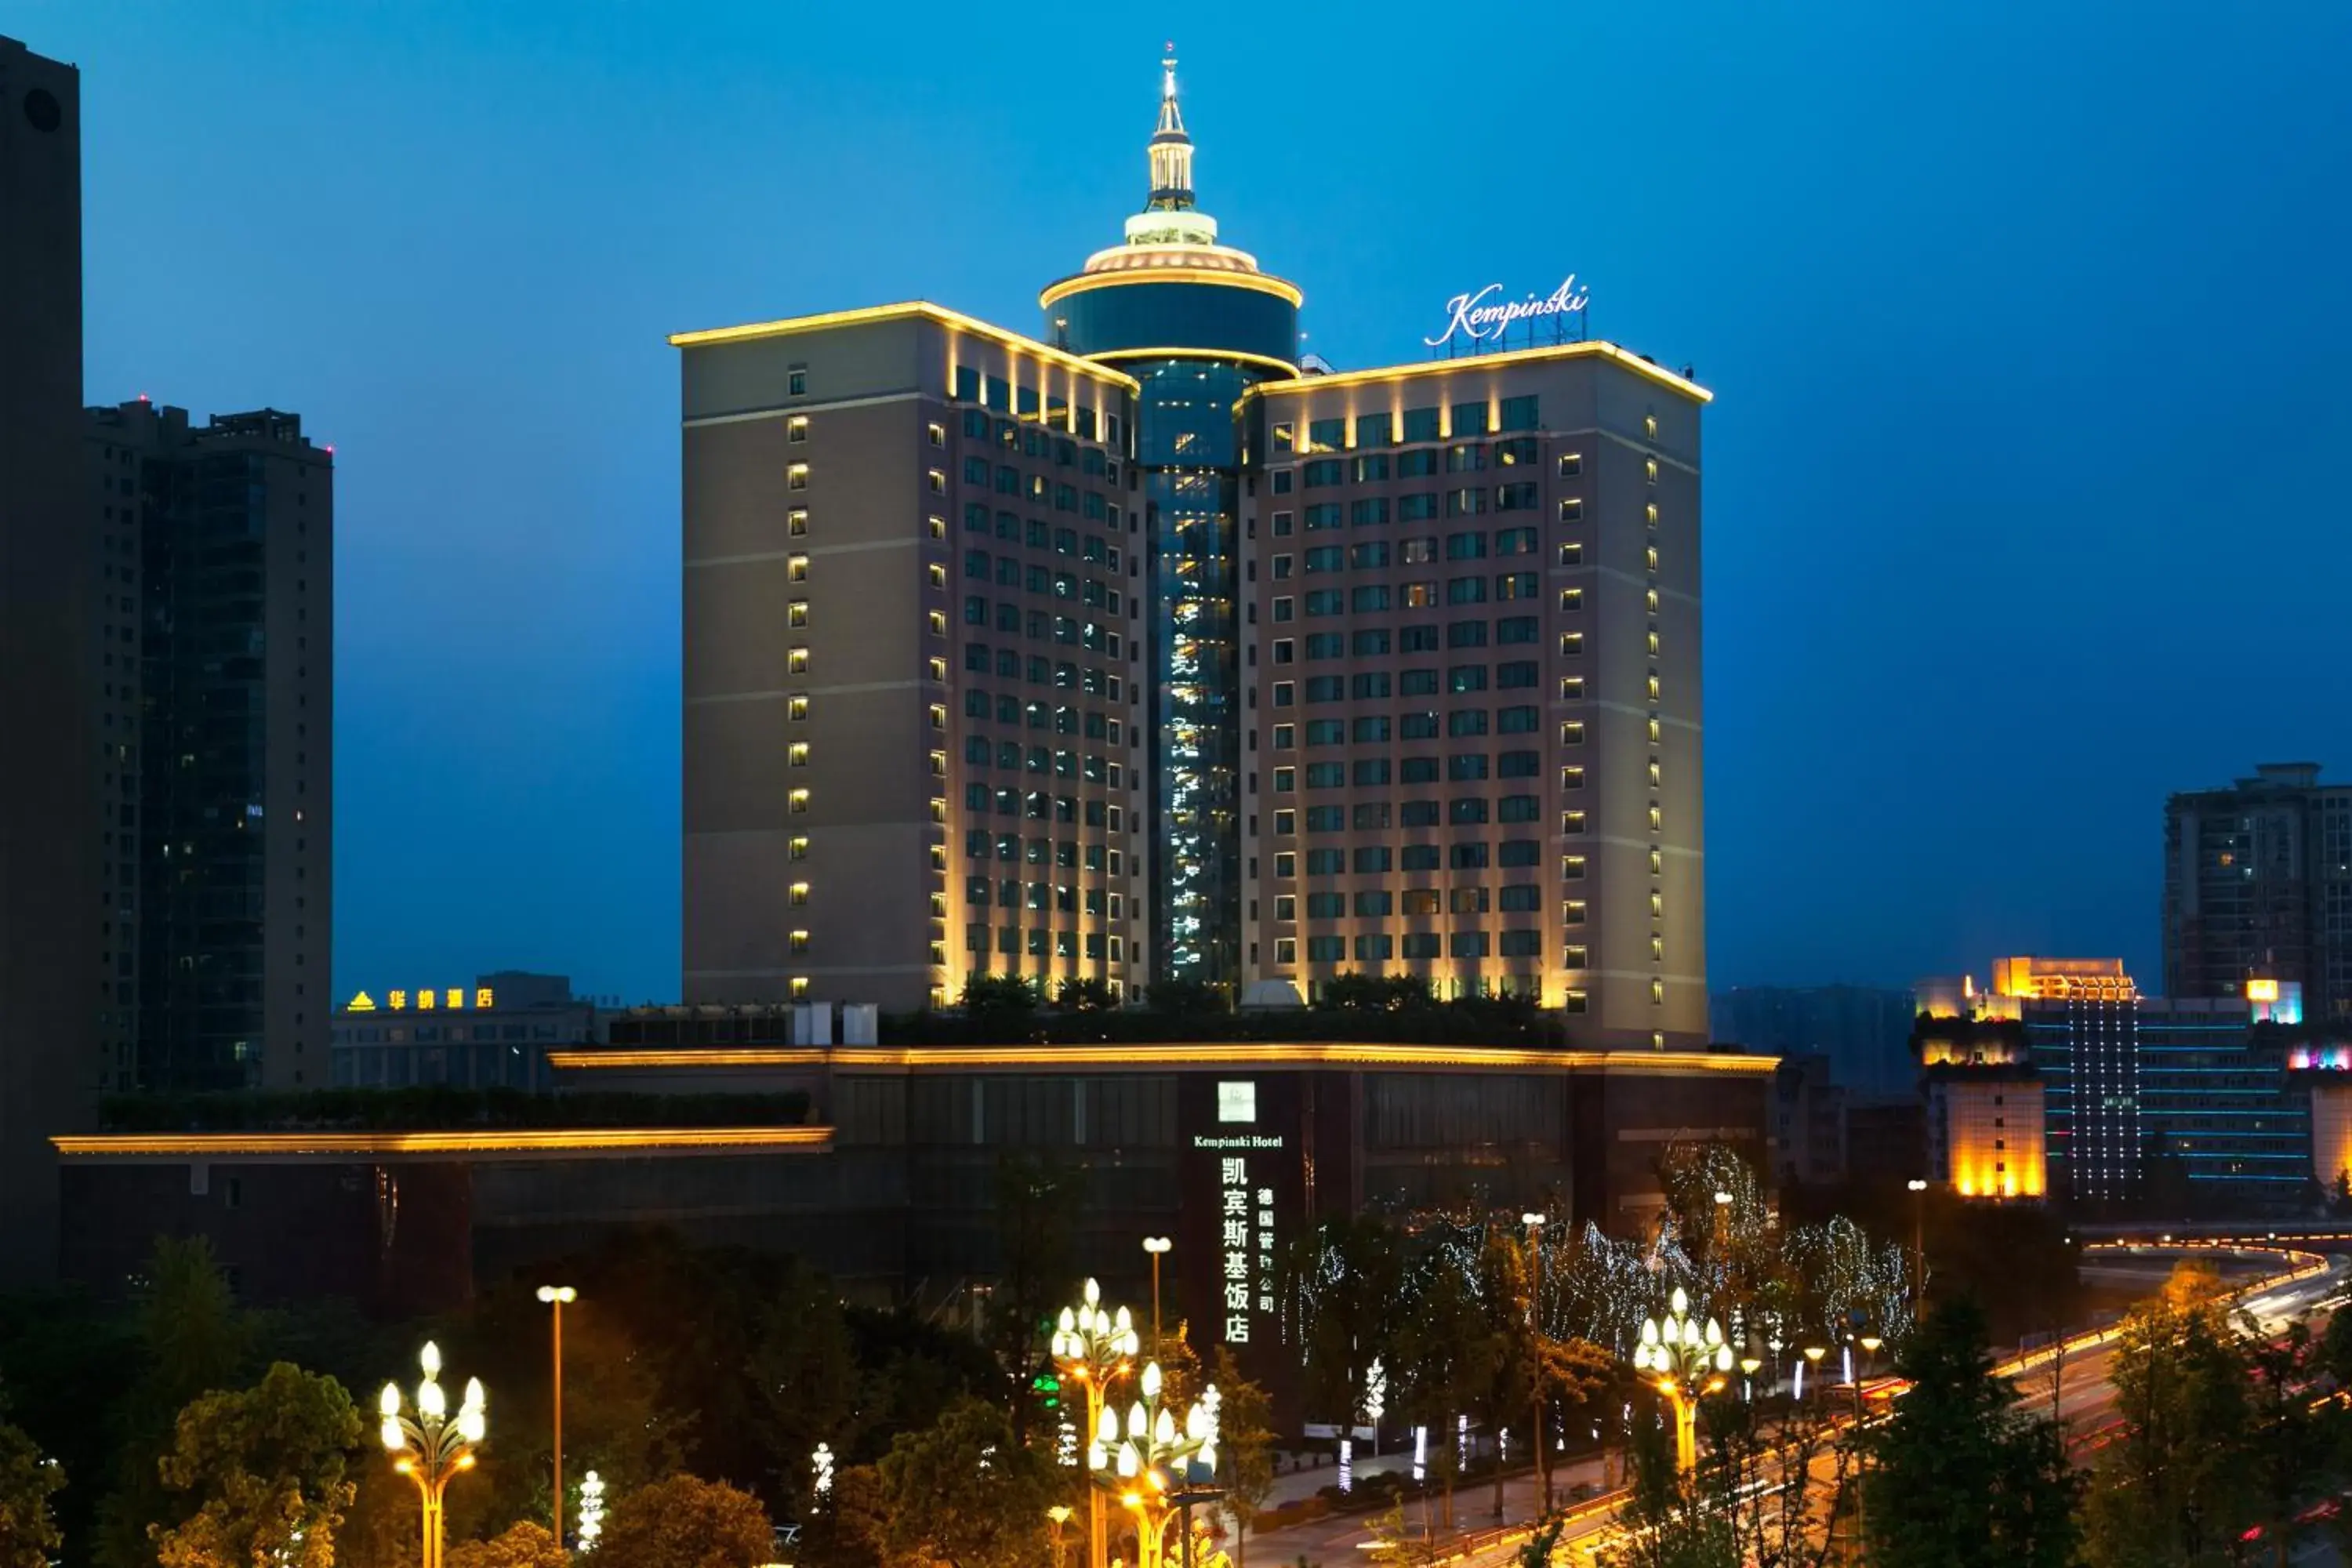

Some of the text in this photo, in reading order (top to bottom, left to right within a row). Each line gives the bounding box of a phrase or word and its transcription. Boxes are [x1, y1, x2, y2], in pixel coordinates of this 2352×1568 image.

[1424, 274, 1589, 346] Kempinski
[1194, 1134, 1283, 1149] Kempinski Hotel
[1221, 1156, 1250, 1344] 凯宾斯基饭店
[1257, 1188, 1275, 1313] 德国管理公司
